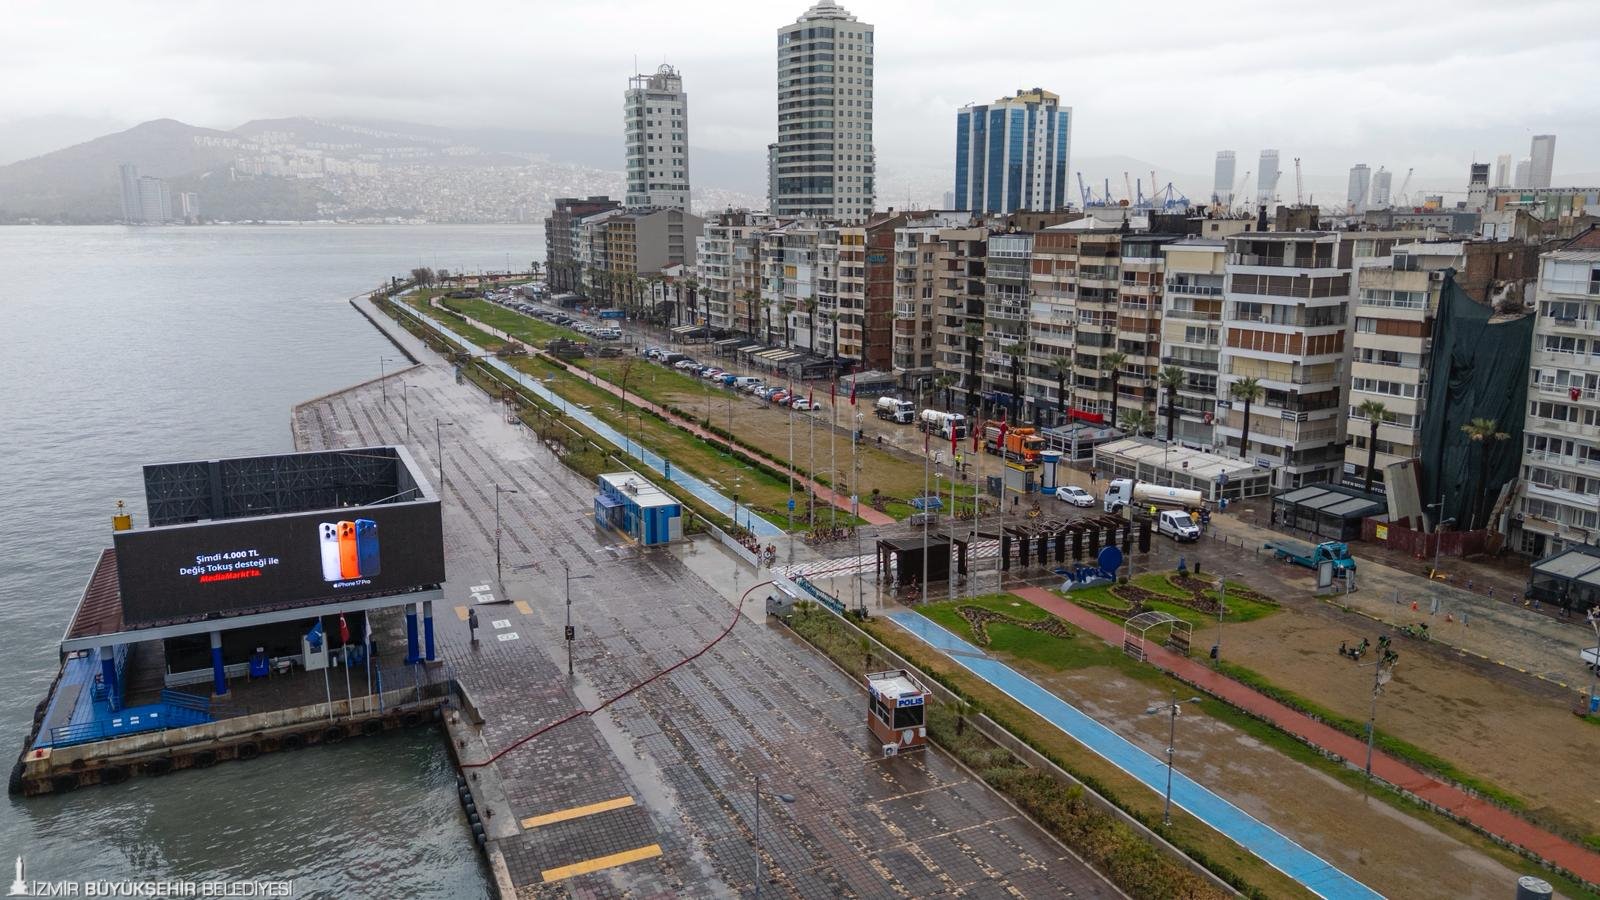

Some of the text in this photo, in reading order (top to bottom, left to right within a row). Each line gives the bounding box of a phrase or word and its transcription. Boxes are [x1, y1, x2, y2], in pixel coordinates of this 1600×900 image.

[196, 549, 259, 564] Şimdi 4.000 TL
[179, 557, 279, 576] Değiş Tokuş desteği ile
